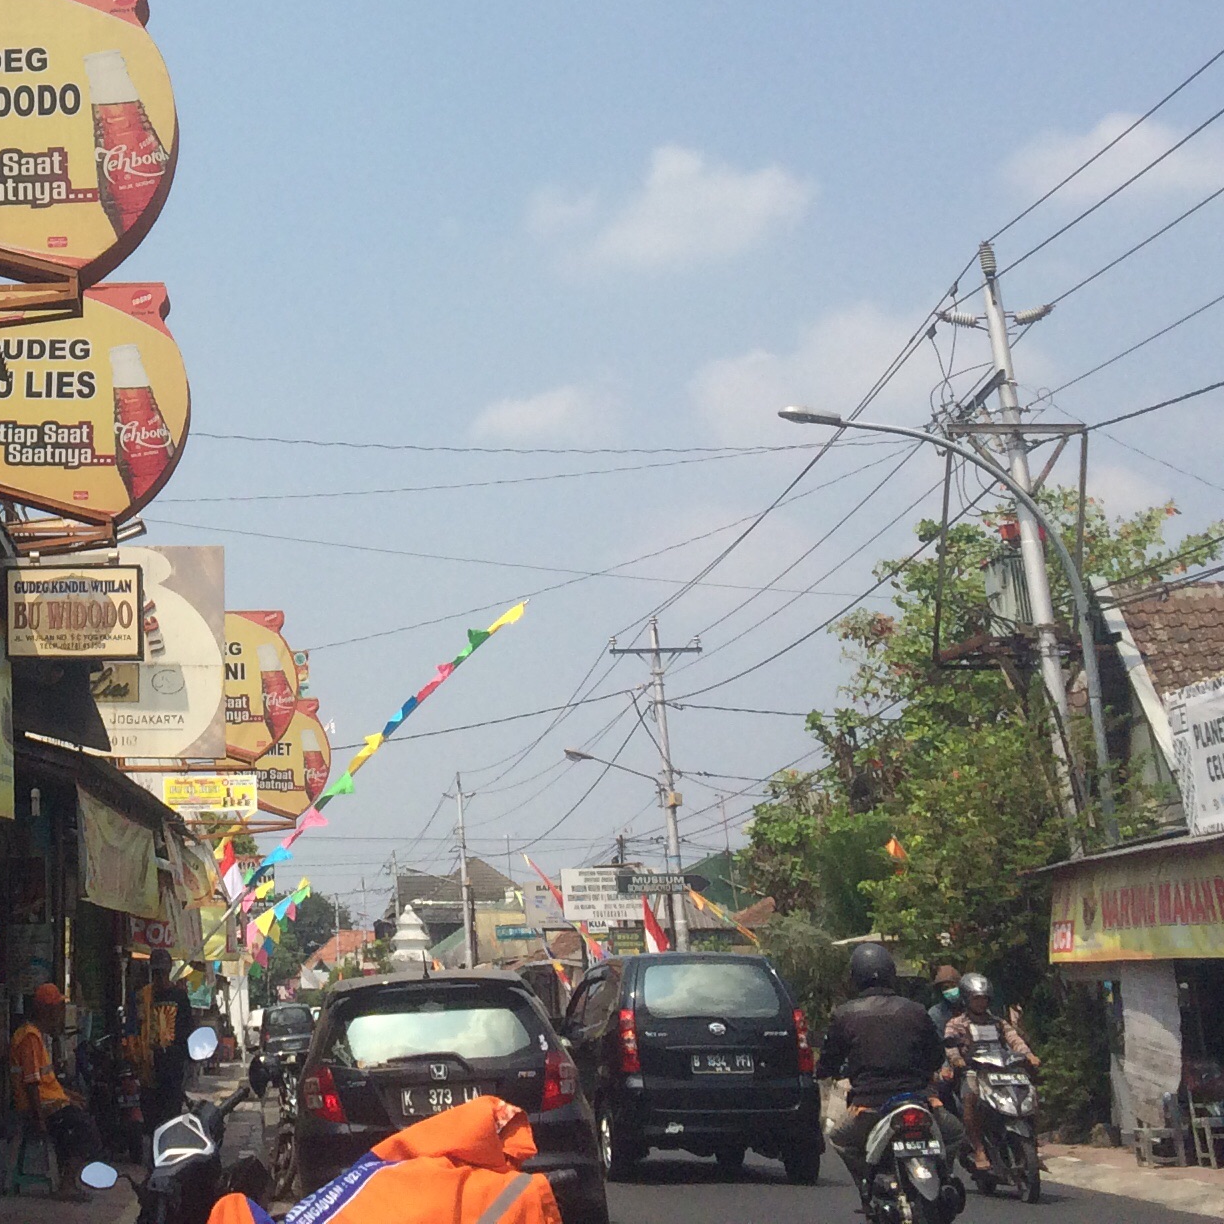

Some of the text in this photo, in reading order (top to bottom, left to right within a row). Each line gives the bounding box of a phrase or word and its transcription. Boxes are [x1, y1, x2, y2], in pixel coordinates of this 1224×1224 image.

[2, 151, 63, 175] Saat
[94, 144, 170, 185] Tehbotol
[2, 339, 92, 361] UDEG
[25, 371, 96, 399] LIES
[44, 424, 90, 443] Saat
[113, 420, 173, 453] Tehbotol
[8, 444, 113, 466] Saatnya...
[14, 579, 132, 595] GUDEG KENDIL WIJILAN
[13, 600, 133, 630] BU WIDODO
[109, 714, 185, 725] JOGJAKARTA
[270, 769, 292, 779] Saat
[631, 875, 685, 884] MUSEUM
[1100, 877, 1218, 930] WARUNG MAKAN
[588, 919, 607, 928] KUA
[403, 1089, 413, 1106] K
[428, 1088, 453, 1105] 373
